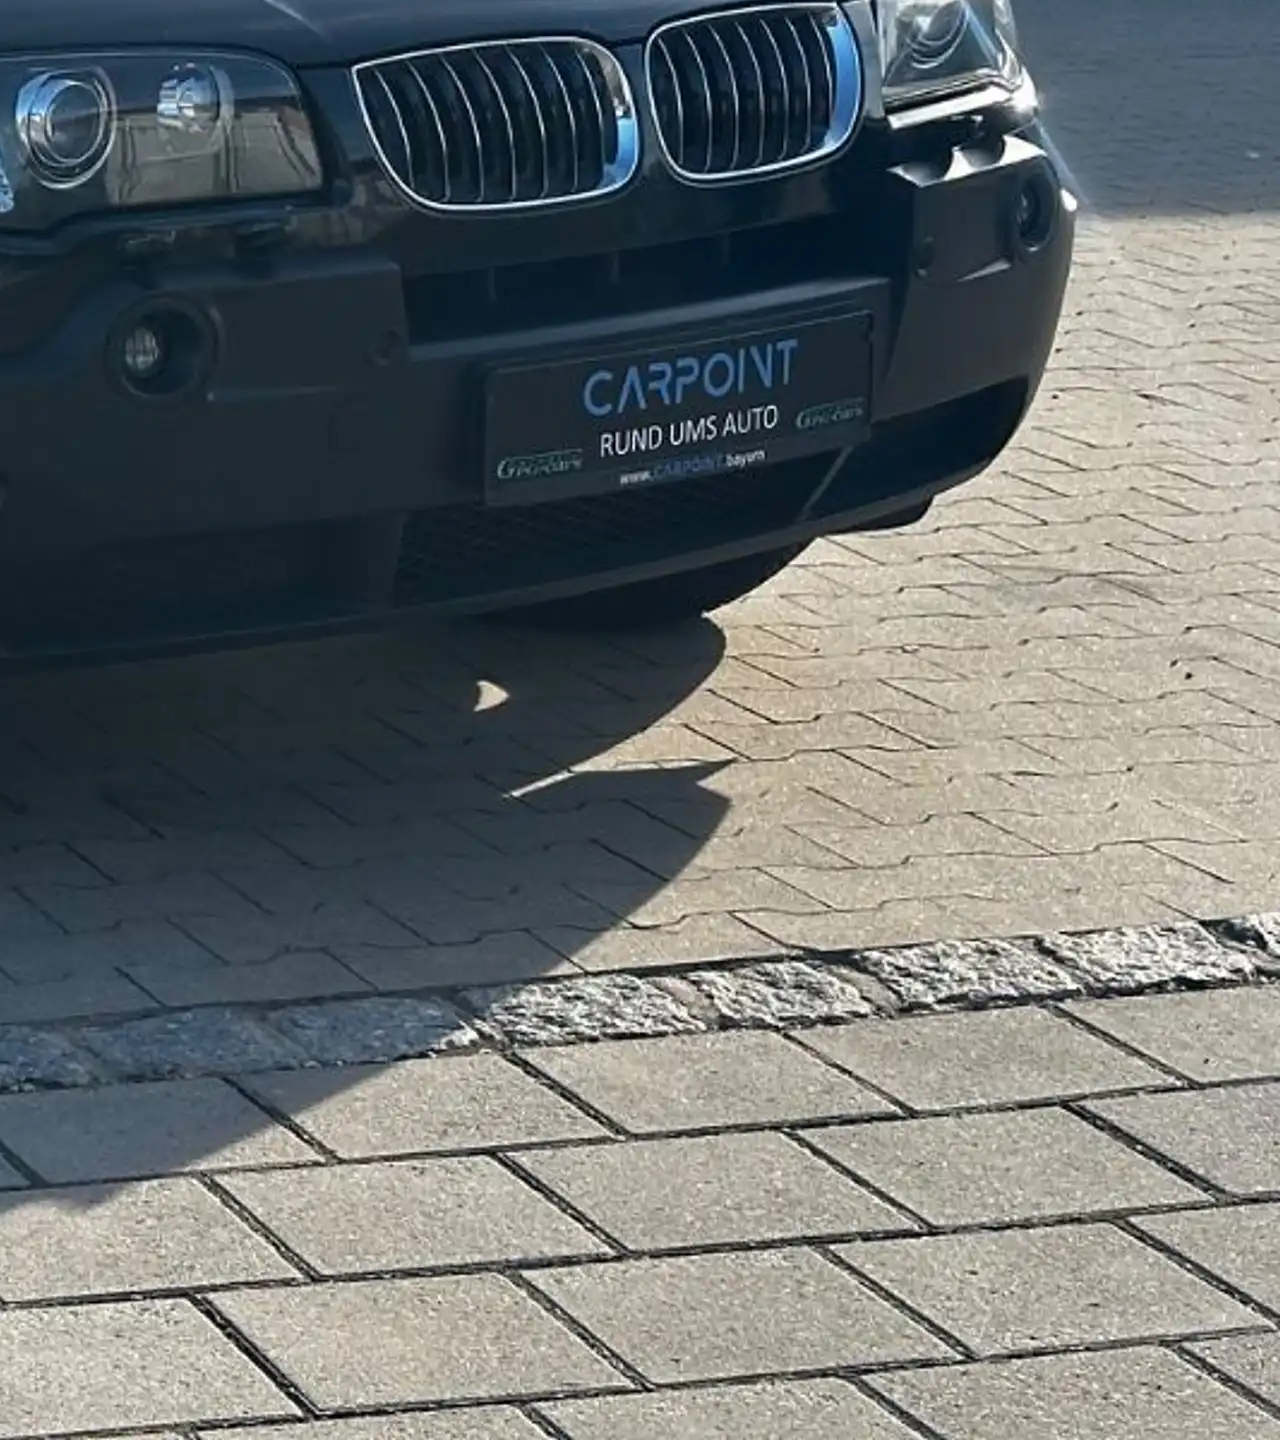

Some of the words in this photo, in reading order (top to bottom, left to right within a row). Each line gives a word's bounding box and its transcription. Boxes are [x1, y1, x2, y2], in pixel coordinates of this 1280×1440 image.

[583, 338, 799, 417] CARPOINT
[600, 424, 663, 458] RUND
[669, 414, 718, 446] UMS
[722, 404, 779, 438] AUTO
